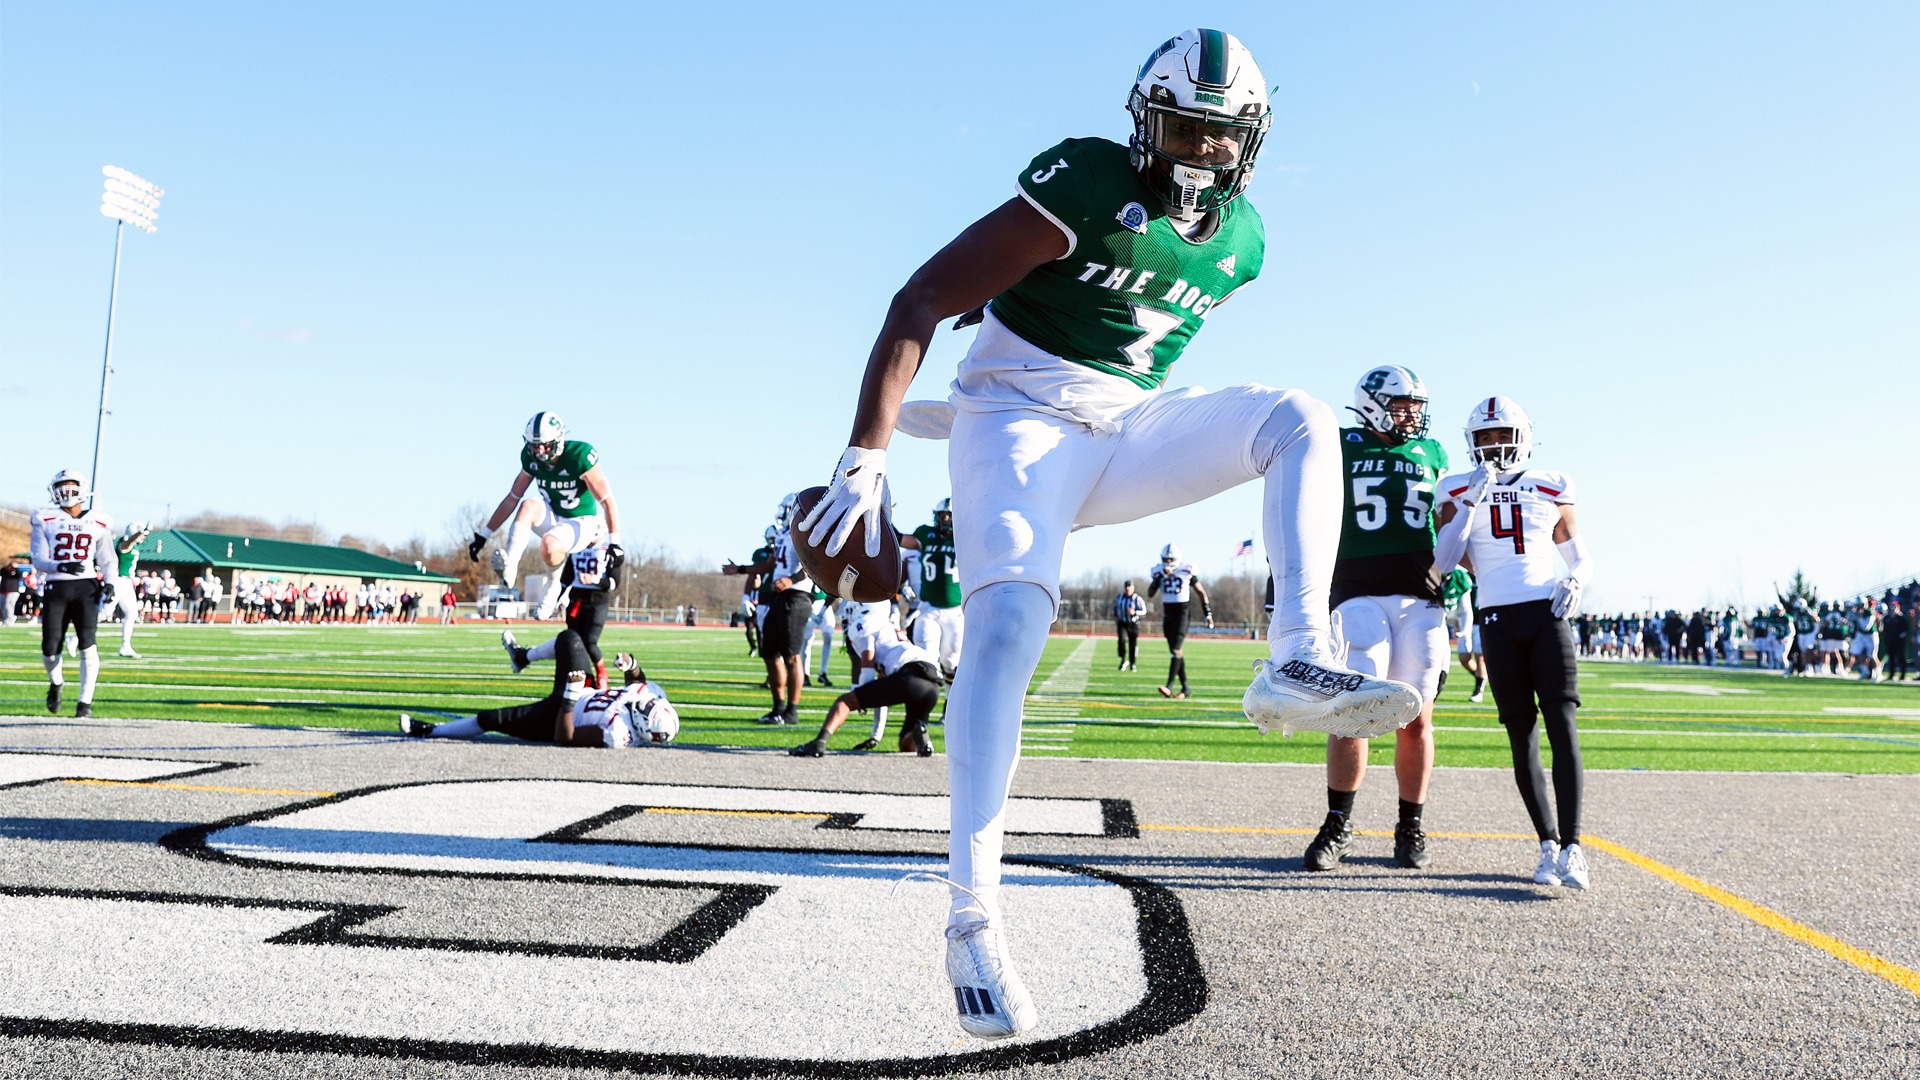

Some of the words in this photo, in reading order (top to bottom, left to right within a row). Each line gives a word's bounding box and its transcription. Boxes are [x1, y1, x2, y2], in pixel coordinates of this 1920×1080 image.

[1193, 91, 1225, 107] ROCK
[1031, 158, 1070, 184] 3
[1127, 210, 1141, 225] 50
[1076, 262, 1157, 294] THE
[1098, 301, 1185, 376] 3
[1351, 459, 1385, 474] THE
[1352, 476, 1430, 530] 55
[1492, 491, 1519, 503] ESU
[1490, 504, 1526, 555] 4
[54, 533, 92, 561] 29
[923, 553, 960, 583] 64
[1164, 577, 1182, 594] 23
